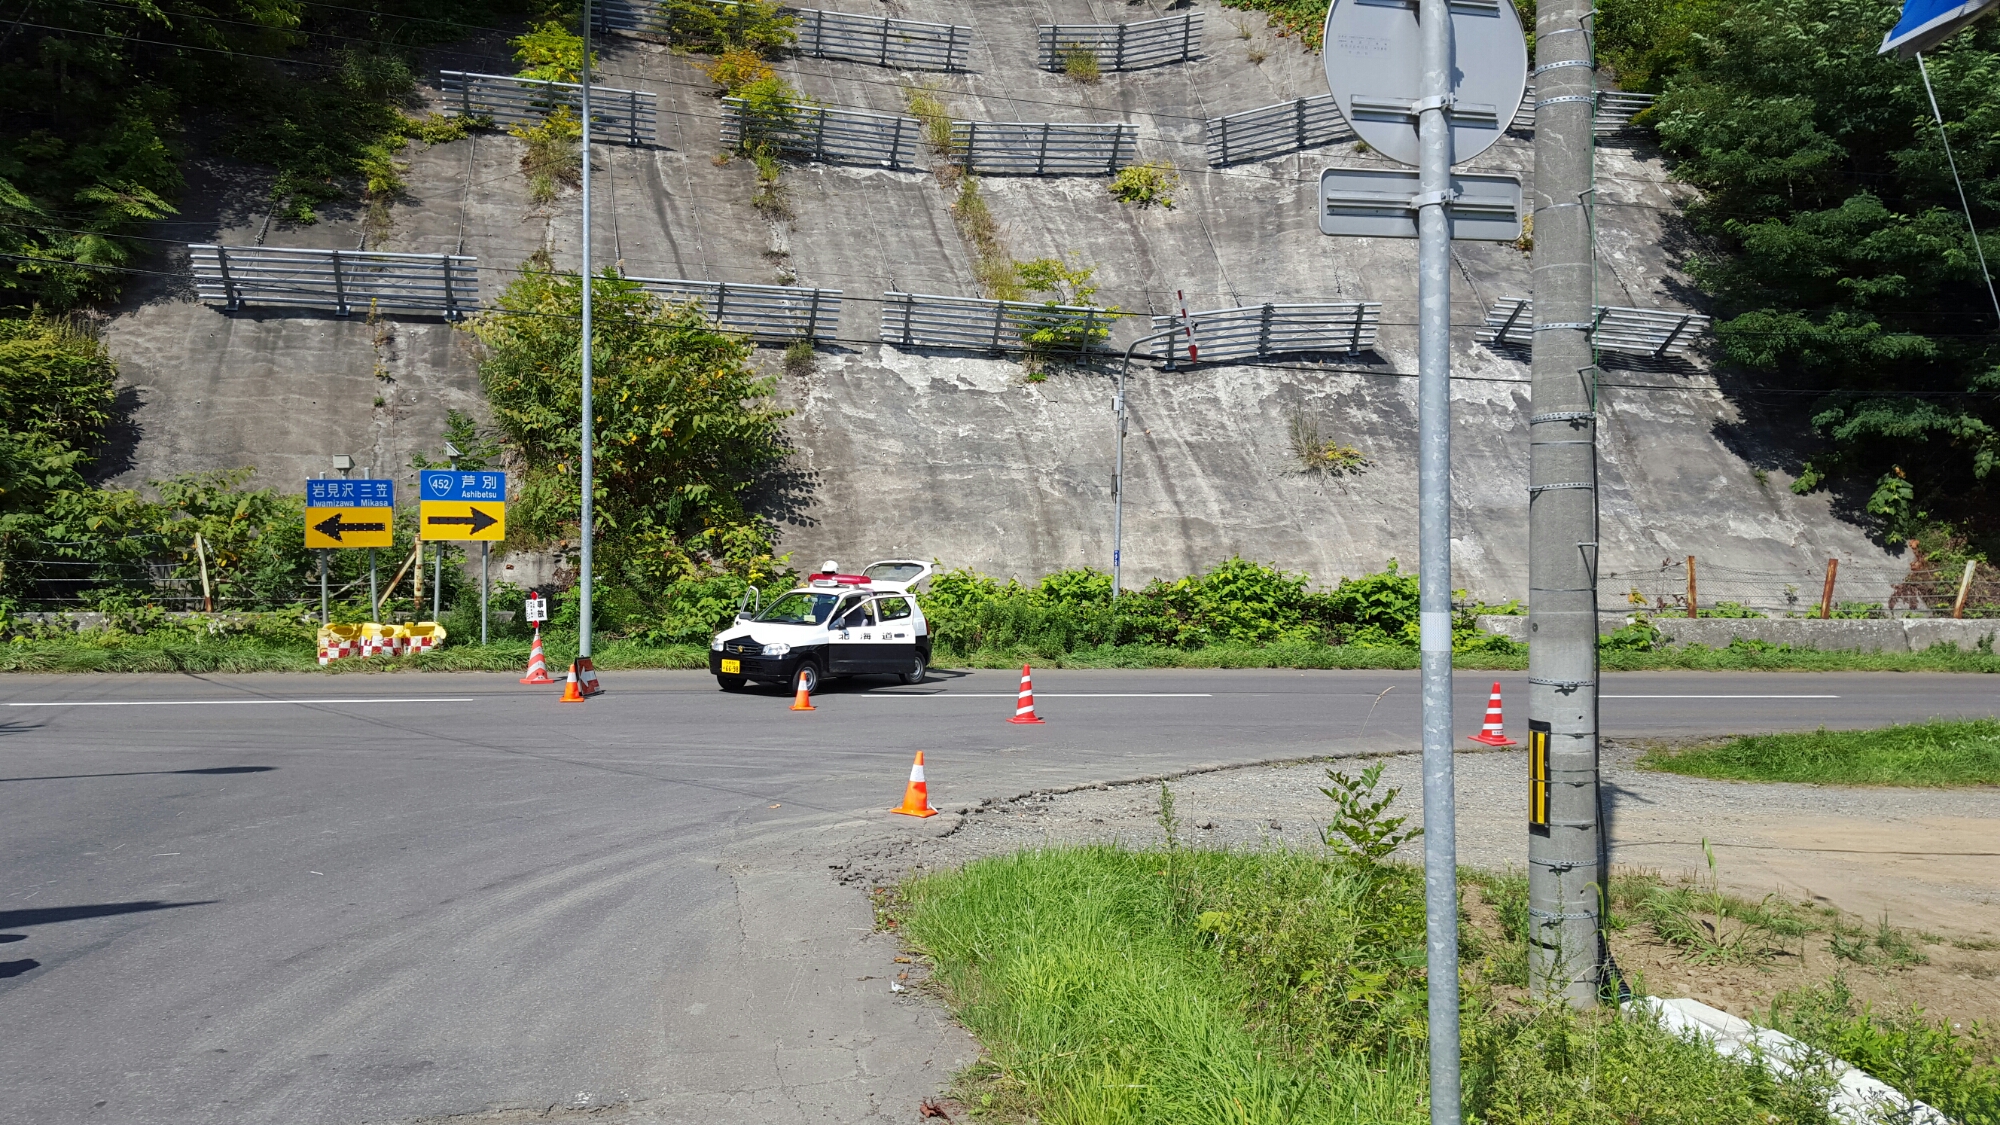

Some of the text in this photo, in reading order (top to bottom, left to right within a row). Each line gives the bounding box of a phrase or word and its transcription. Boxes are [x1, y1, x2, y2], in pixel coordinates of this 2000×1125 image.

[432, 479, 449, 489] 452
[461, 475, 497, 489] 芦別
[312, 483, 388, 498] 岩見沢 三笠
[461, 490, 497, 499] Ashibetsu
[313, 499, 388, 507] Iwamizawa Mikasa
